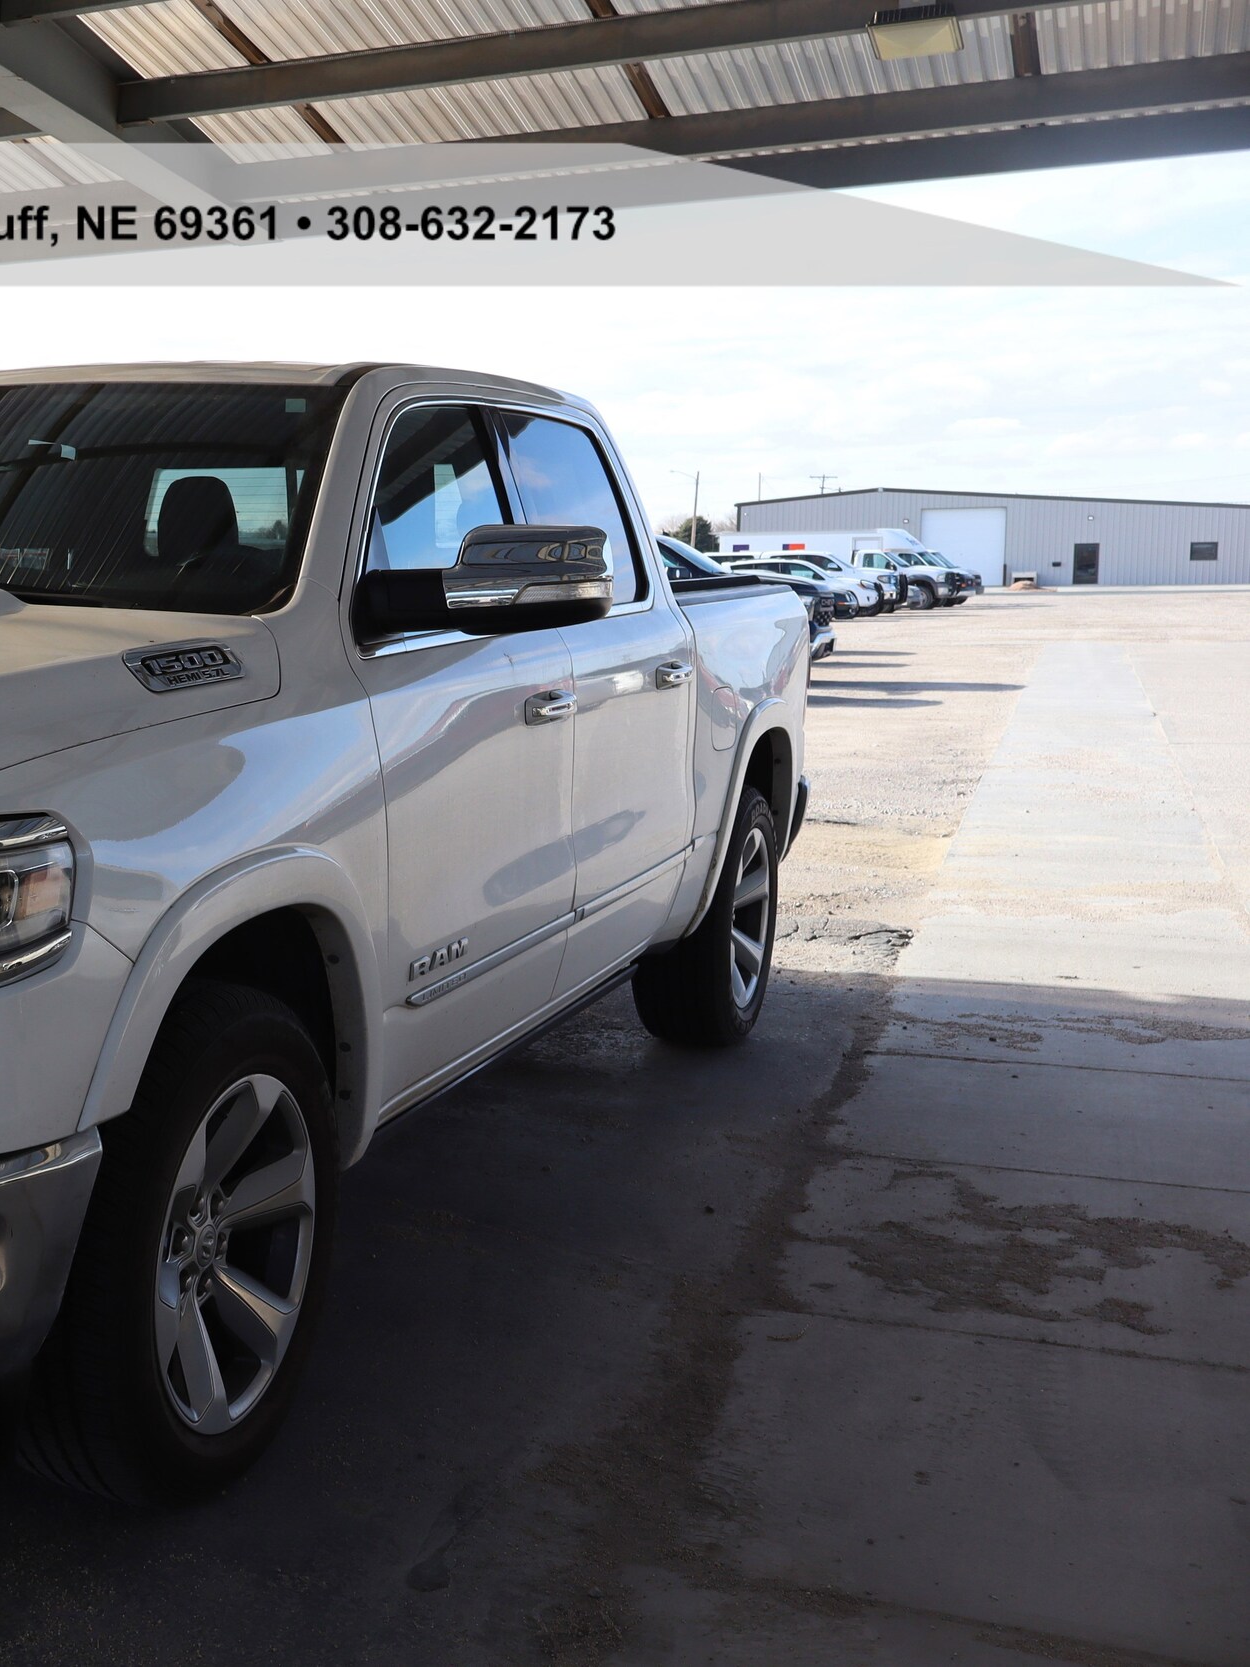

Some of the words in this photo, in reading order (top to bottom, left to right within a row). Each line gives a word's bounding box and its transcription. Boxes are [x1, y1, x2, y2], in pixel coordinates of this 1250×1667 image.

[145, 650, 224, 675] 1500
[167, 673, 201, 686] HEMI
[203, 668, 230, 680] 5.7L
[409, 936, 469, 982] RAM
